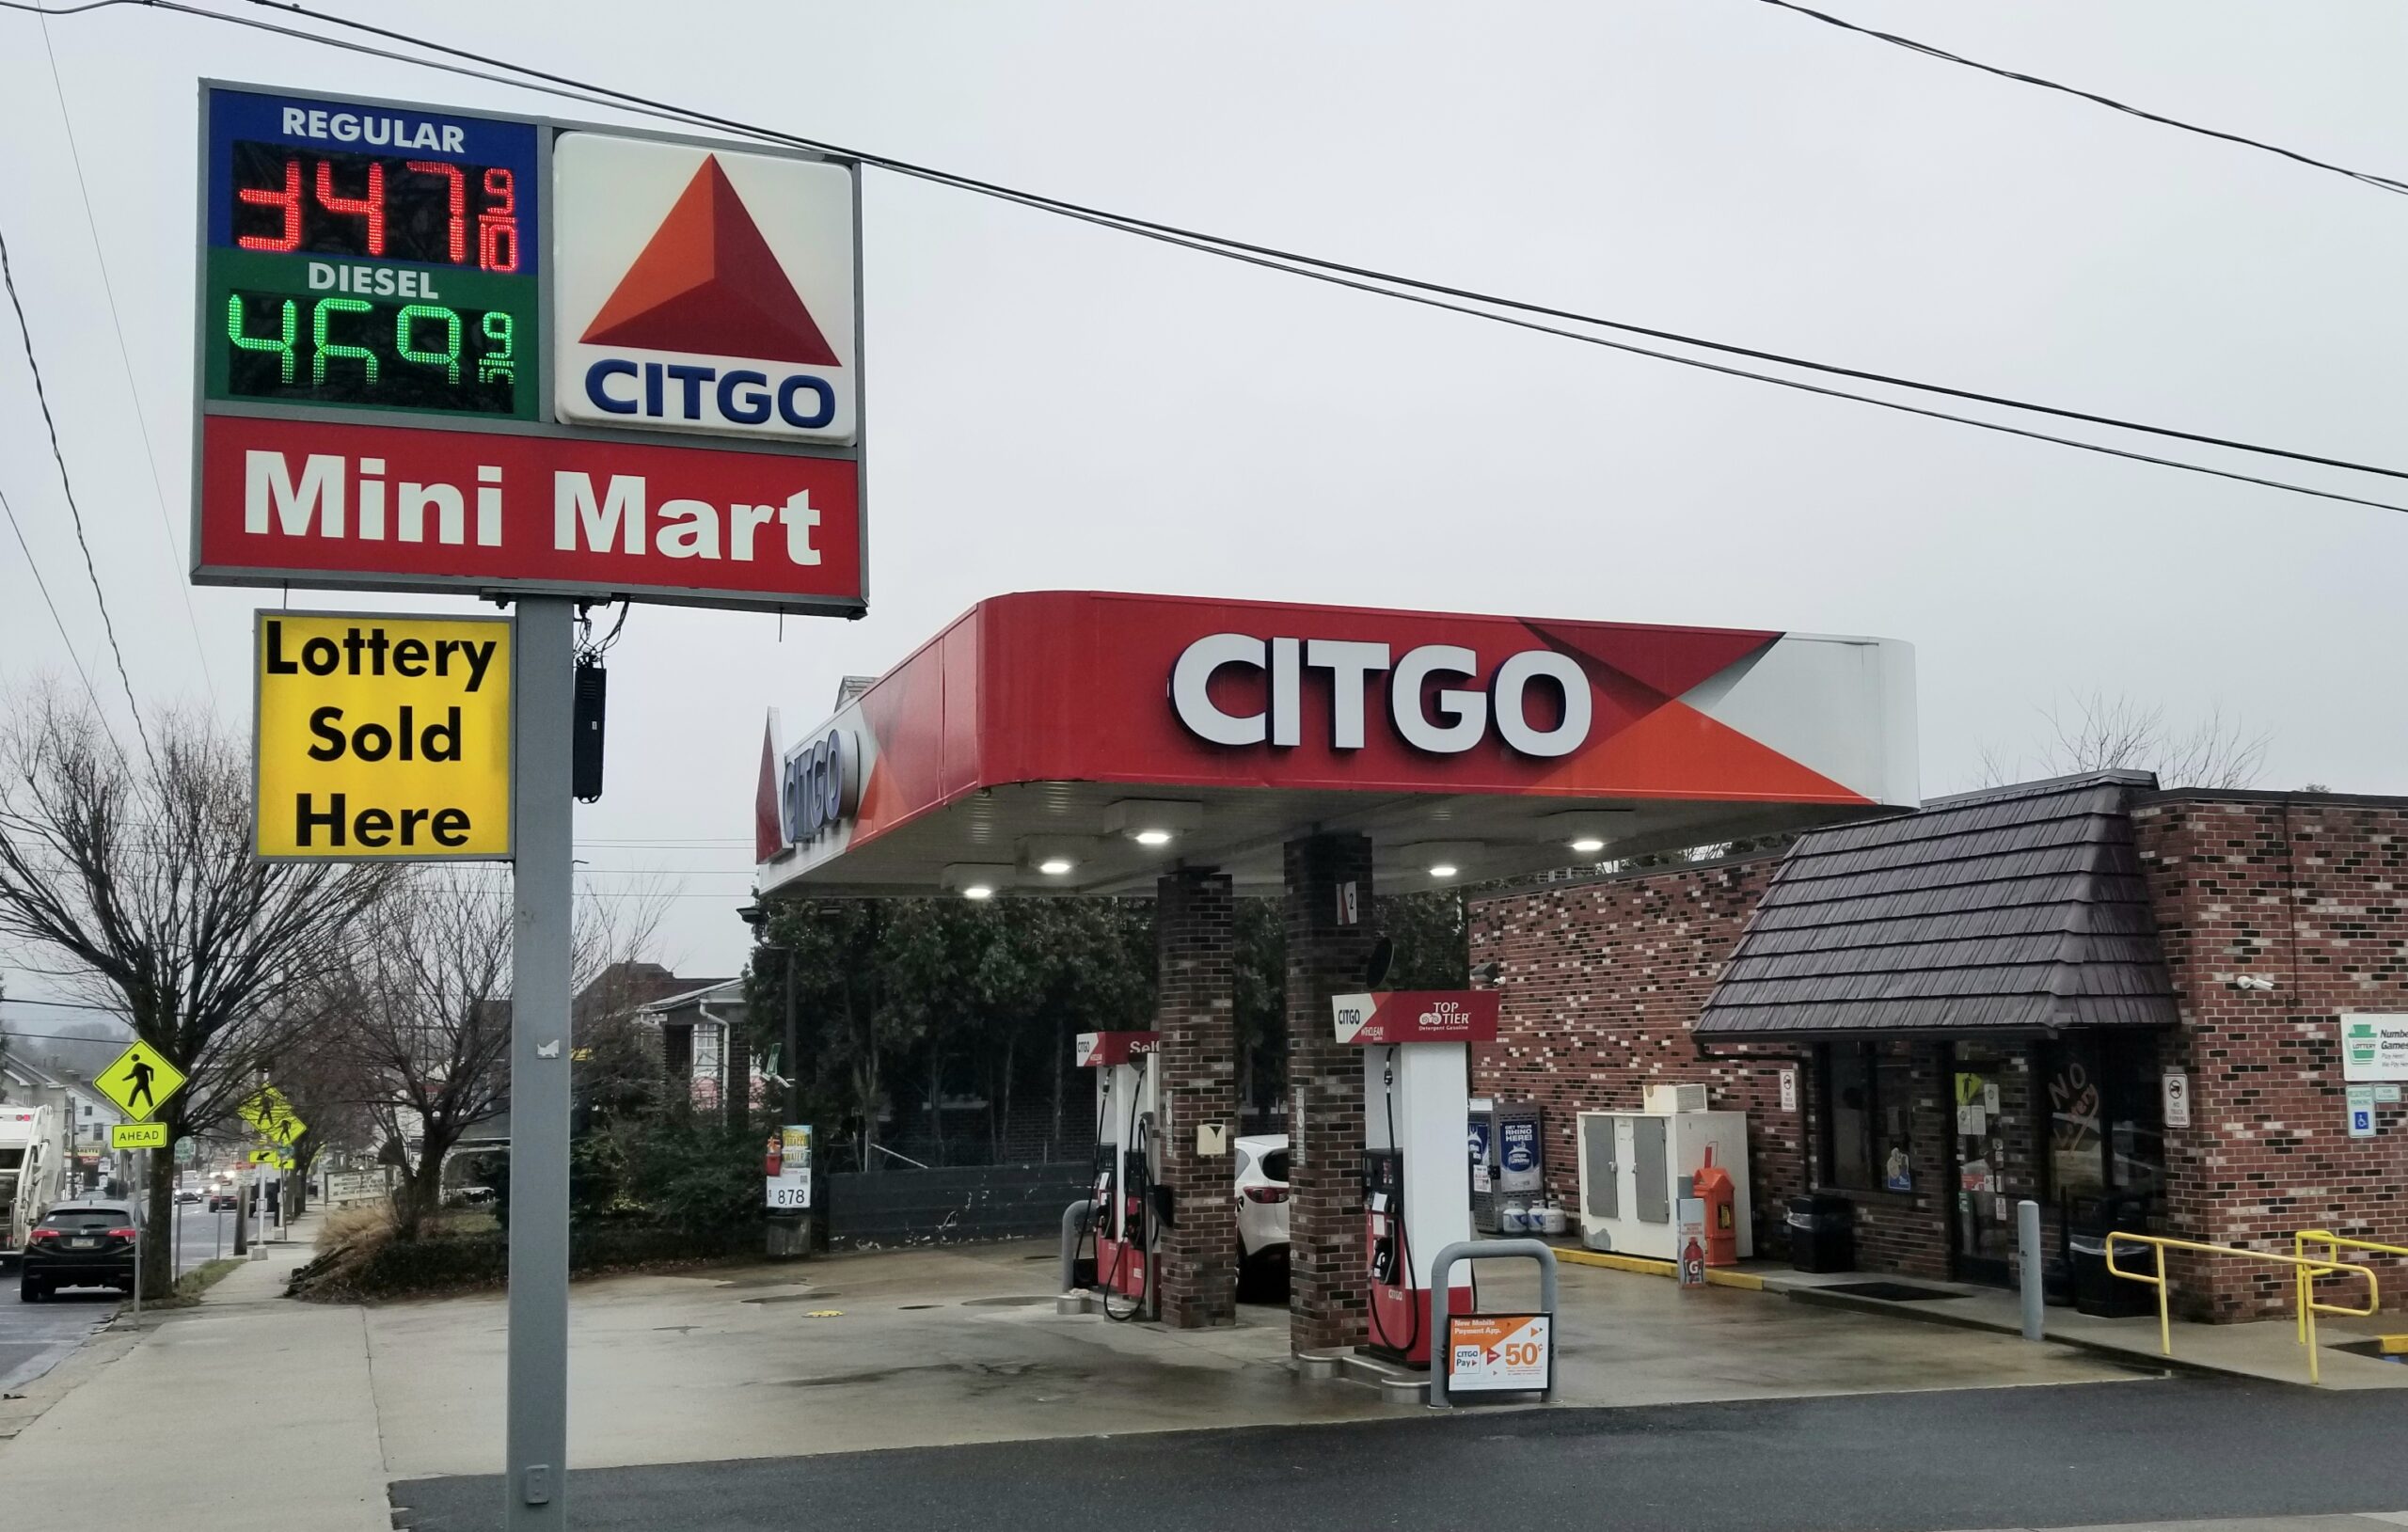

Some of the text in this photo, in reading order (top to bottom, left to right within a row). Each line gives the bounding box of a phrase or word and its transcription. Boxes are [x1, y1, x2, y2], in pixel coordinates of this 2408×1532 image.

[282, 106, 465, 153] REGULAR
[309, 261, 438, 300] DIESEL
[583, 359, 836, 429] CITGO
[244, 450, 822, 567] Mini Mart
[266, 621, 498, 692] Lottery
[1169, 632, 1592, 757] CITGO
[307, 705, 461, 763] Sold
[783, 729, 847, 845] CITGO
[295, 793, 471, 847] Here
[1348, 892, 1354, 910] 2
[1338, 1009, 1360, 1025] CITGO
[1434, 1002, 1459, 1013] TOP
[1443, 1013, 1469, 1024] TIER
[2049, 1063, 2086, 1111] NO
[119, 1130, 159, 1141] AHEAD
[1688, 1260, 1700, 1274] G
[1454, 1327, 1502, 1335] Payment App.
[1456, 1359, 1471, 1368] Pay
